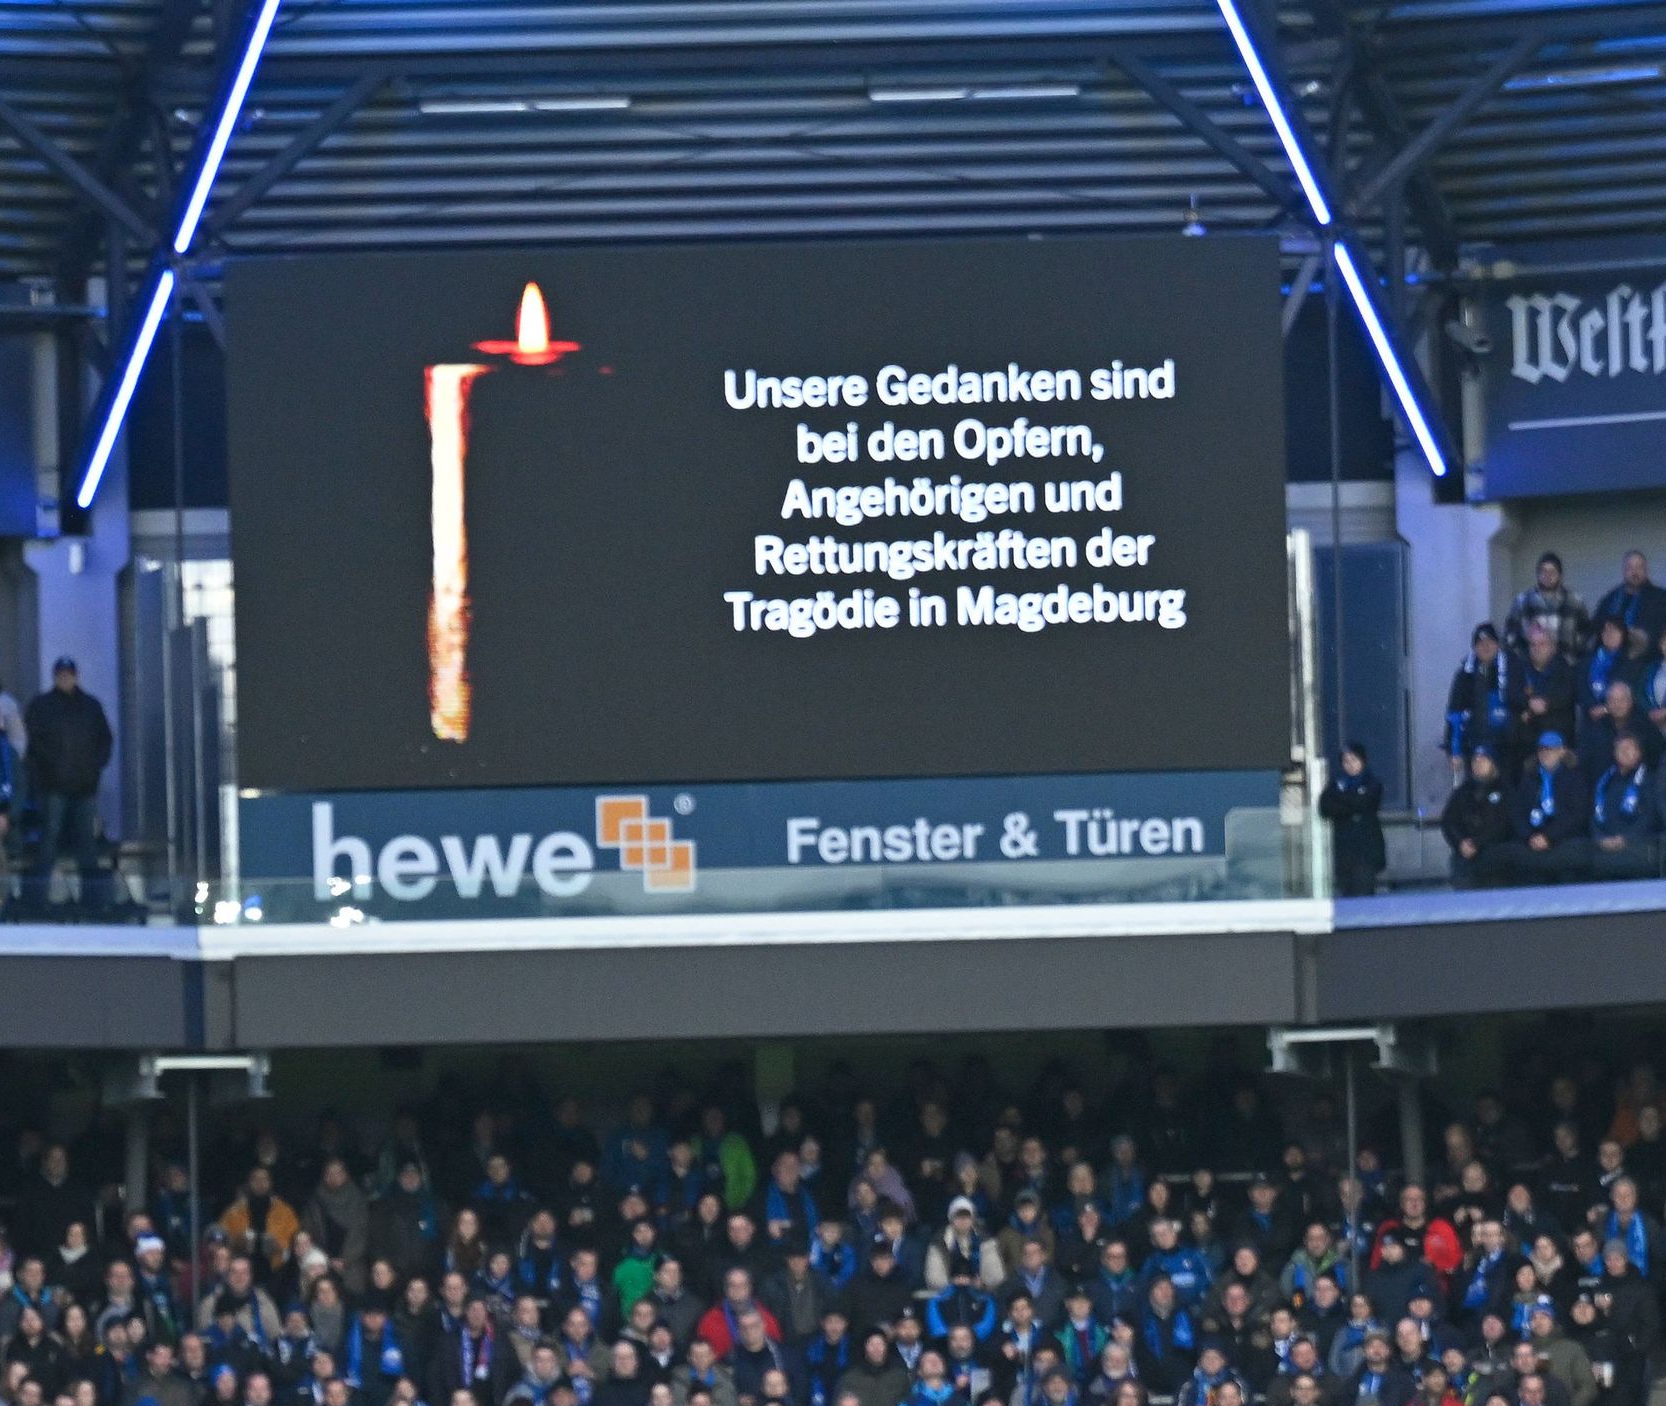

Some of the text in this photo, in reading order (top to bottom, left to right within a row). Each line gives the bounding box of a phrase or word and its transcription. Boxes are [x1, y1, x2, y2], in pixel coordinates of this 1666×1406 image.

[724, 358, 1176, 410] Unsere Gedanken sind
[796, 416, 1105, 466] bei den Opfern,
[780, 470, 1123, 526] Angehörigen und
[754, 526, 1156, 580] Rettungskräften der
[723, 582, 1187, 639] Tragödie in Magdeburg
[312, 801, 594, 900] hewe
[786, 807, 1204, 864] Fenster & Türen
